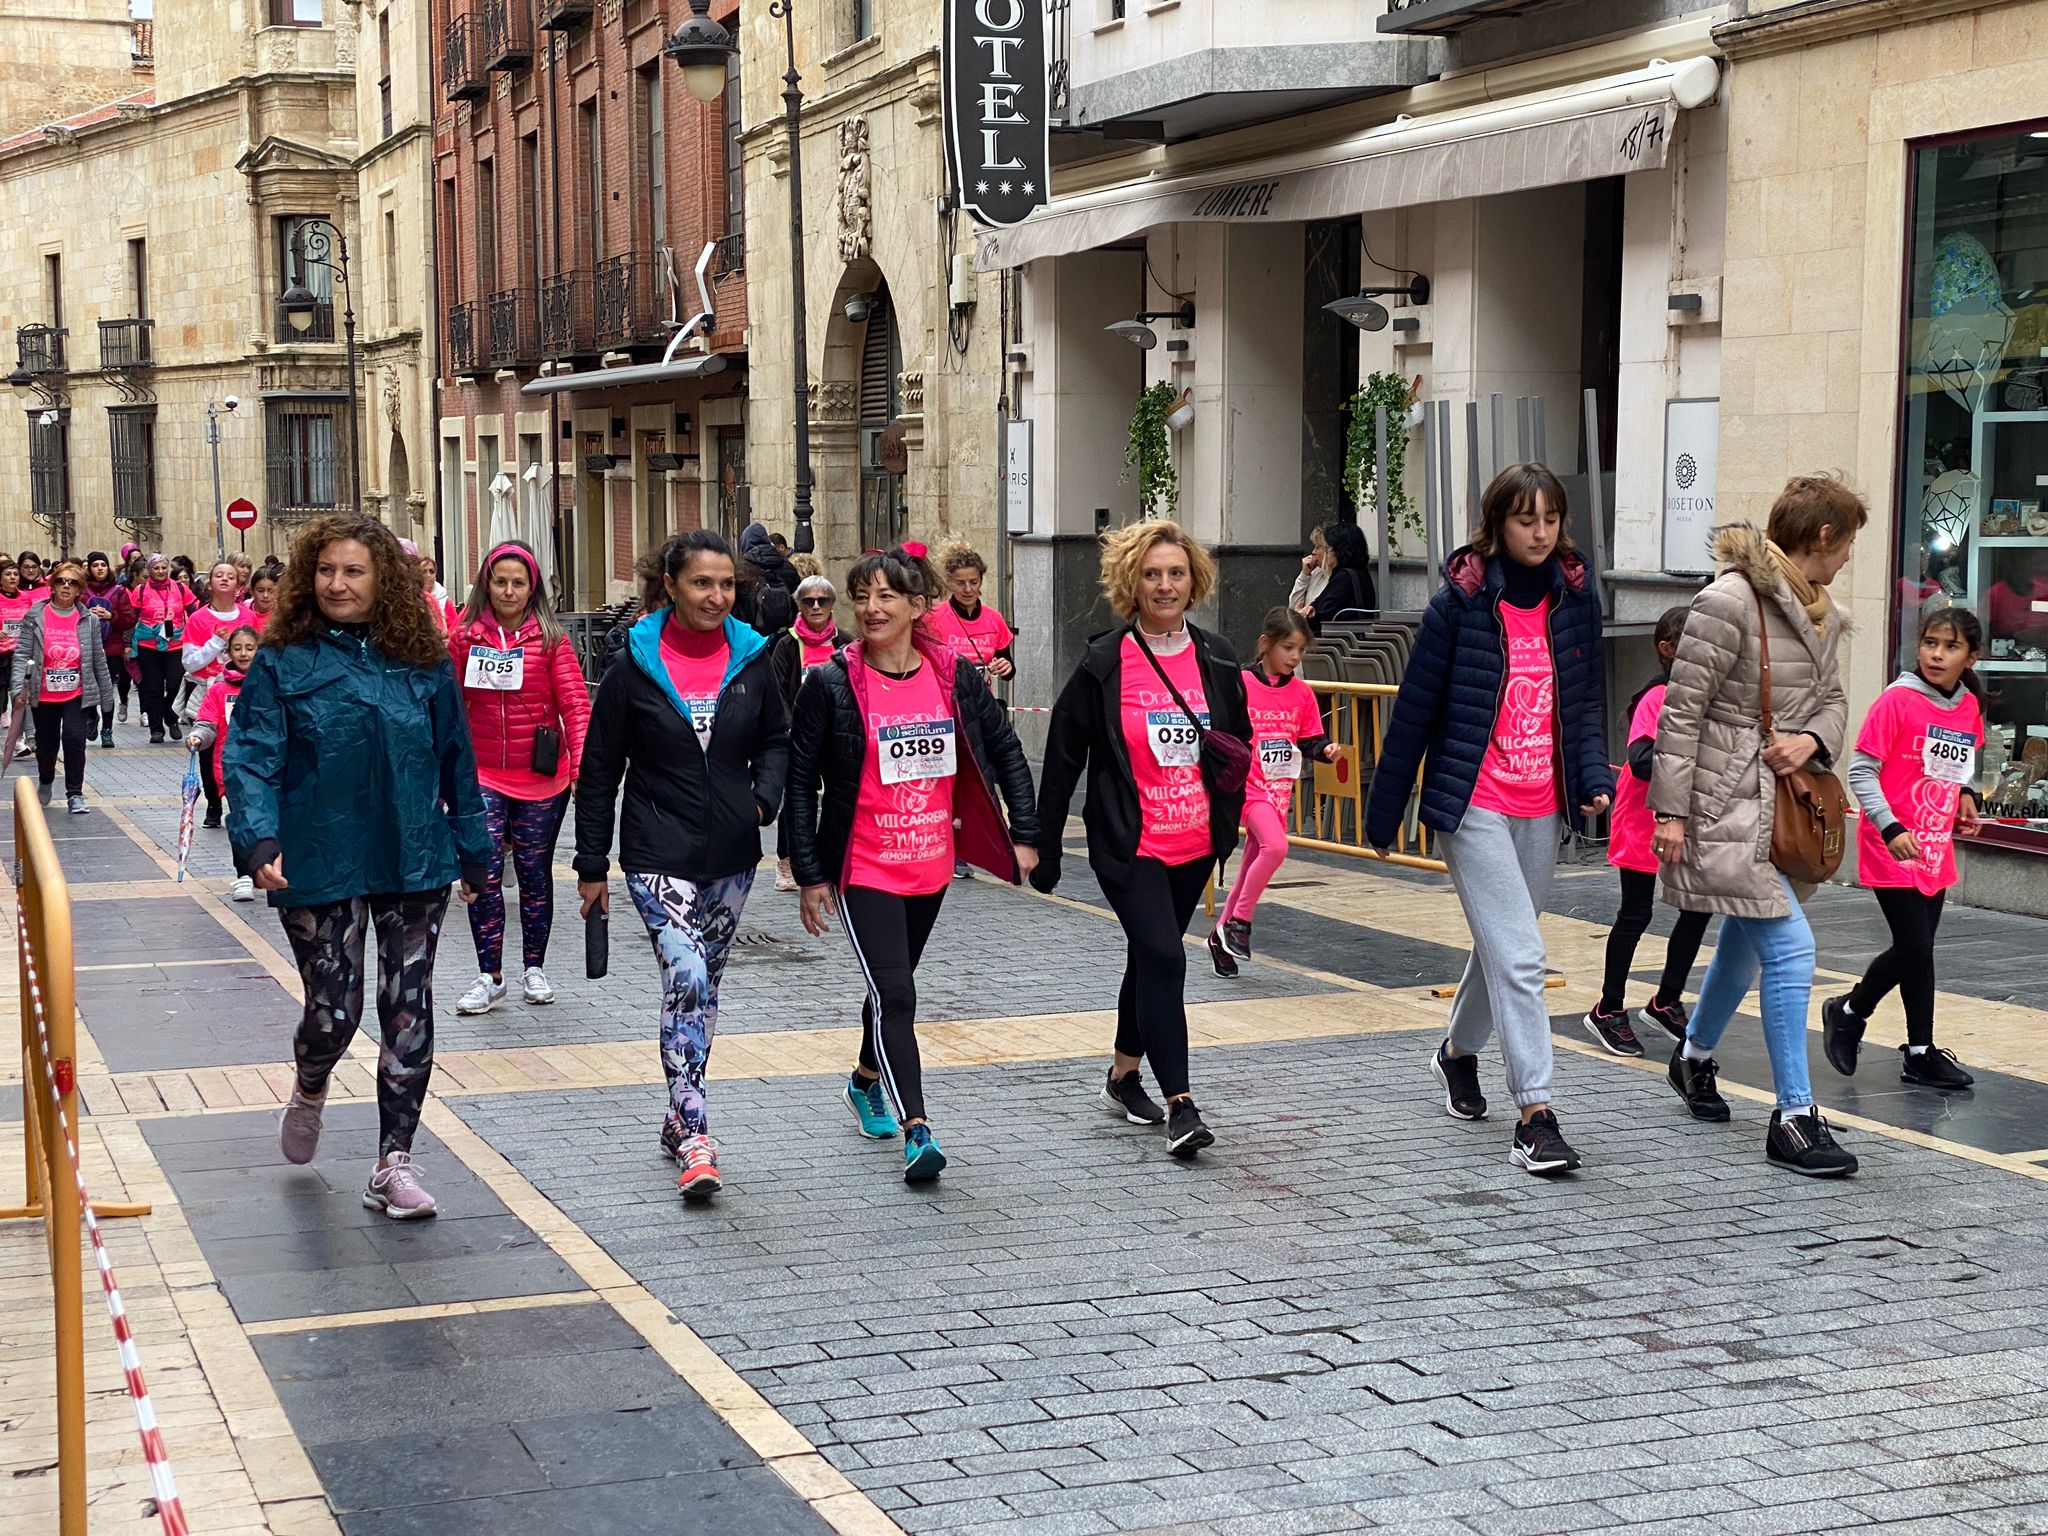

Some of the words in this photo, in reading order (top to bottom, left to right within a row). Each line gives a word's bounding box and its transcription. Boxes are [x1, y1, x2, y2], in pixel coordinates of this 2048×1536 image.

[1192, 181, 1281, 217] LUMIERE
[478, 659, 513, 674] 1055
[50, 675, 76, 684] 2660
[1158, 727, 1198, 745] 039
[1513, 732, 1552, 749] CARRE
[890, 738, 946, 759] 0389
[1262, 749, 1293, 763] 4719
[1930, 742, 1968, 762] 4805
[1144, 786, 1168, 800] VIII
[1169, 782, 1205, 799] CARR
[874, 813, 899, 828] VIII
[892, 829, 941, 852] Mujer
[1917, 830, 1952, 843] CARR
